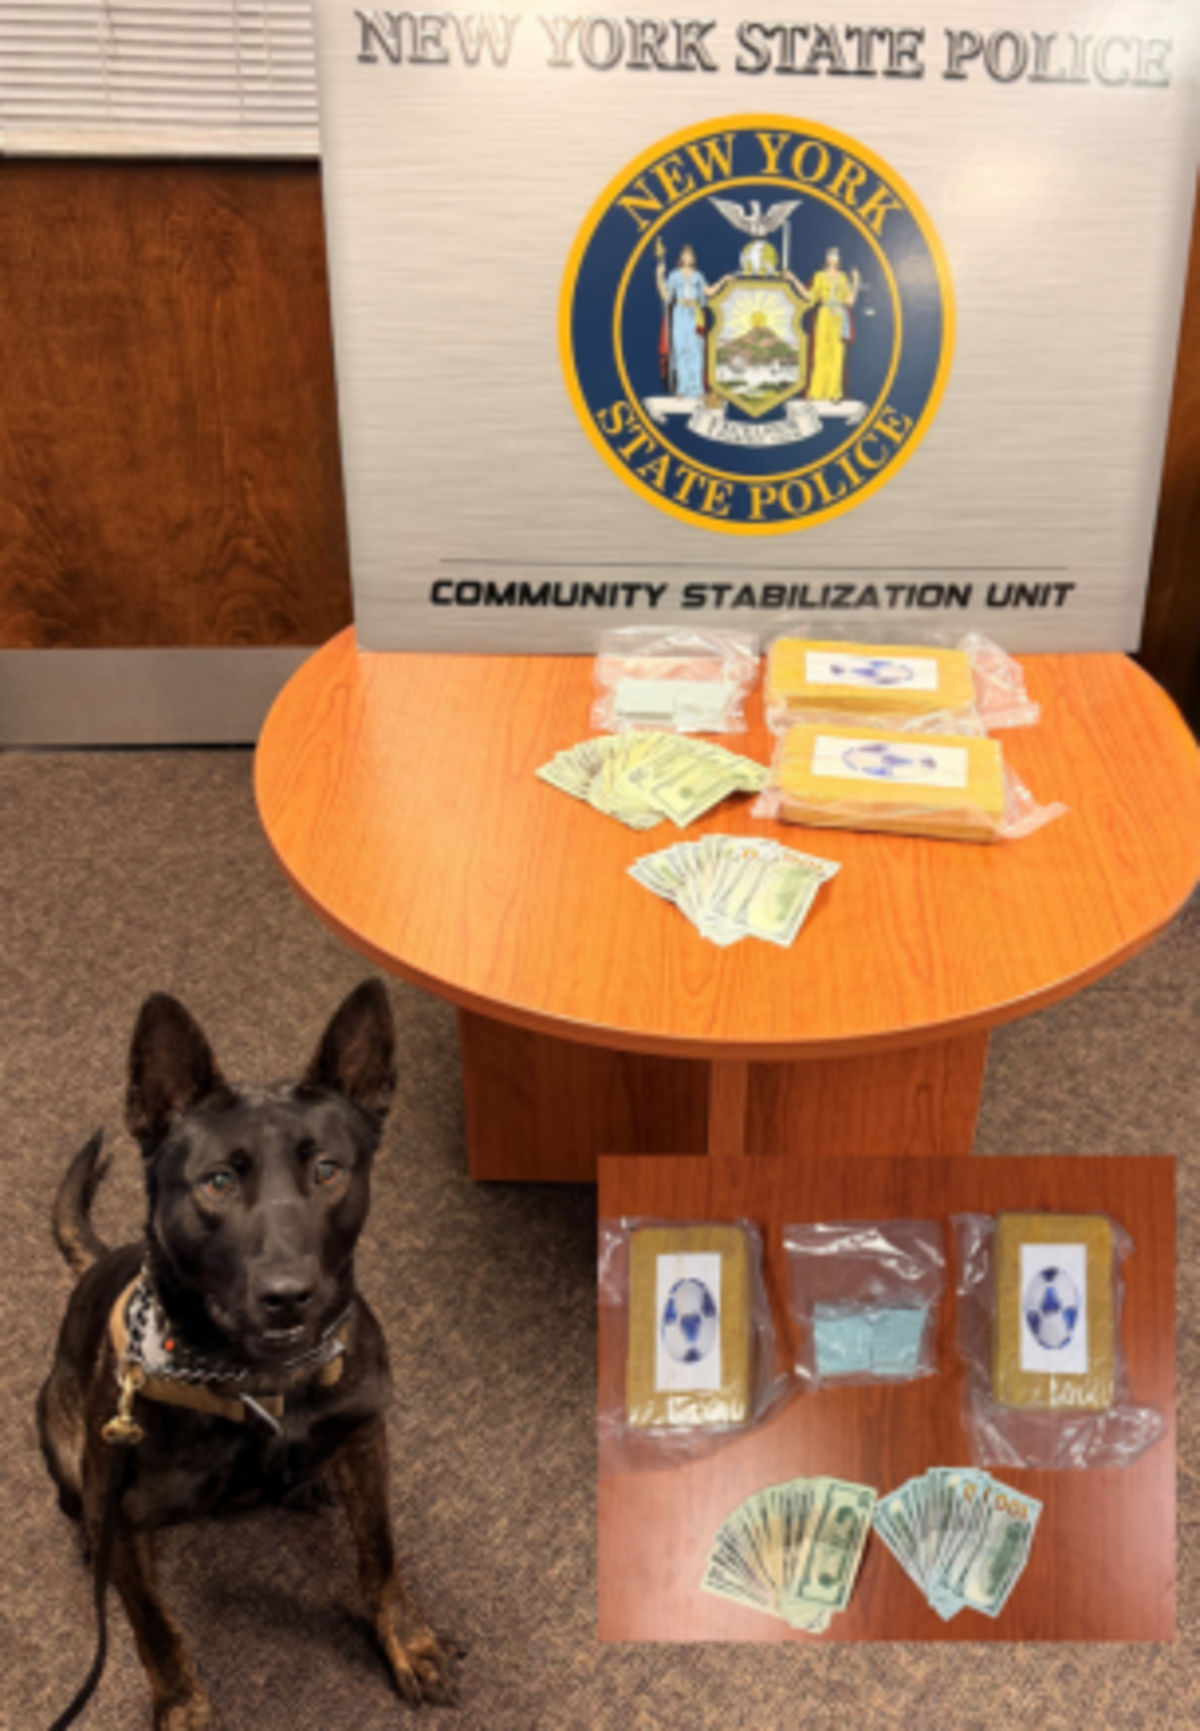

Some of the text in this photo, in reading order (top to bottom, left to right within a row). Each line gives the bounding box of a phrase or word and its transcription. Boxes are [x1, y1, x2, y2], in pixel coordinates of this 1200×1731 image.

[356, 10, 1172, 87] NEW YORK STATE POLICE
[617, 133, 901, 236] NEW YORK
[597, 400, 912, 520] STATE POLICE
[431, 580, 1075, 610] COMMUNITY STABILIZATION UNIT
